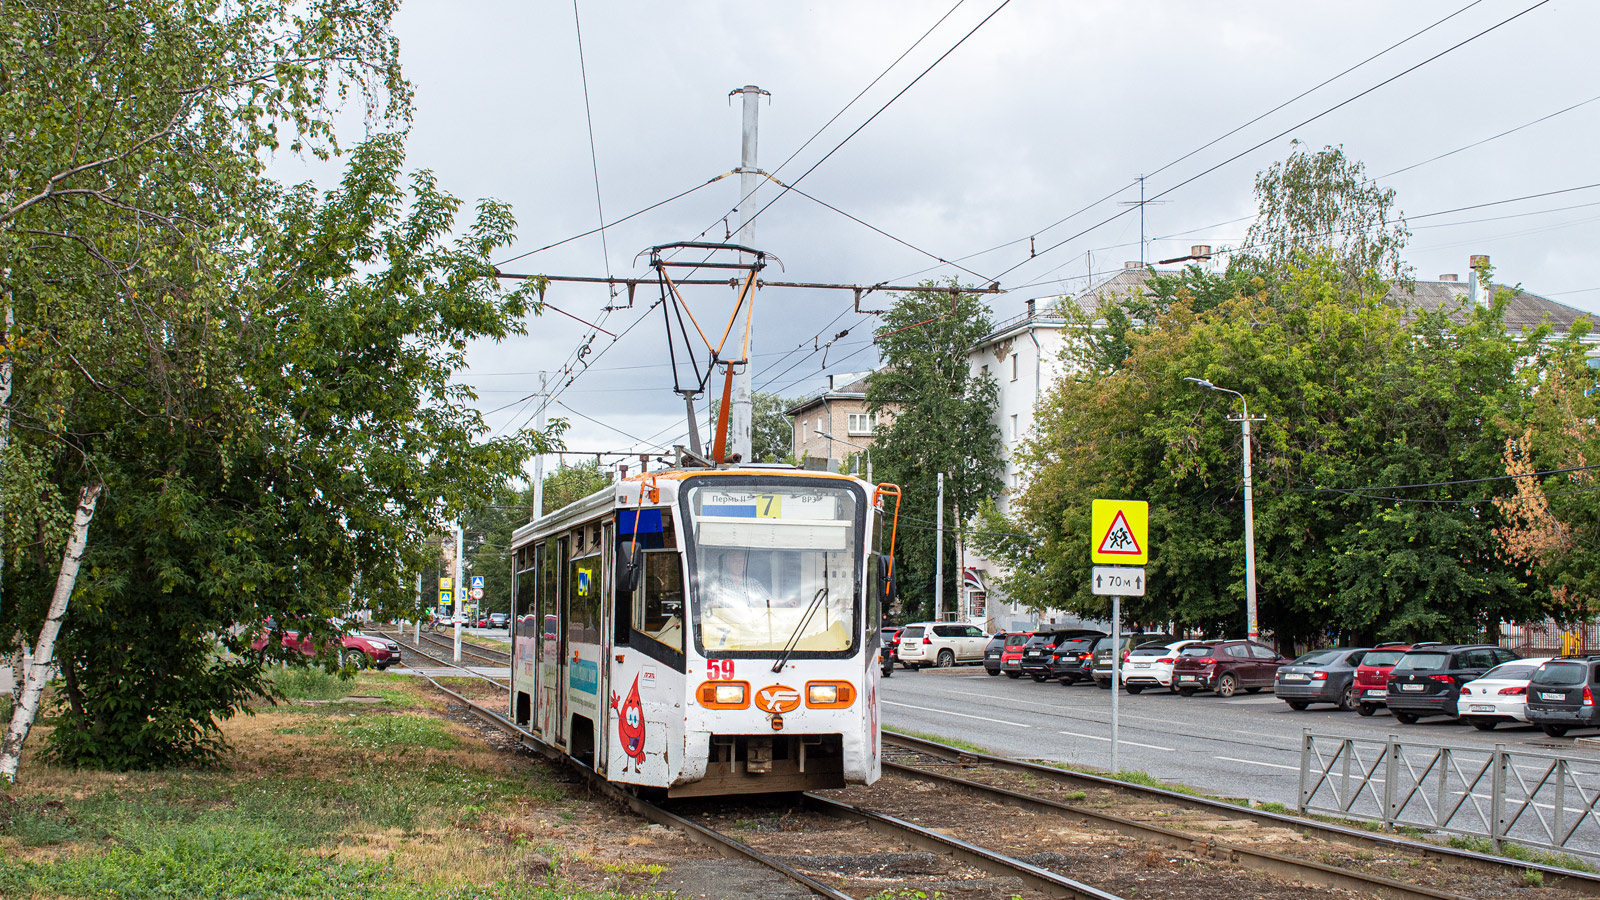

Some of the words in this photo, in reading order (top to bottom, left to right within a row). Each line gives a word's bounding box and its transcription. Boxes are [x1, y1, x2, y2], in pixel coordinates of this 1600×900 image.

[712, 495, 739, 504] Пермь
[761, 495, 775, 516] 7
[716, 627, 732, 646] 7
[706, 658, 735, 681] 59
